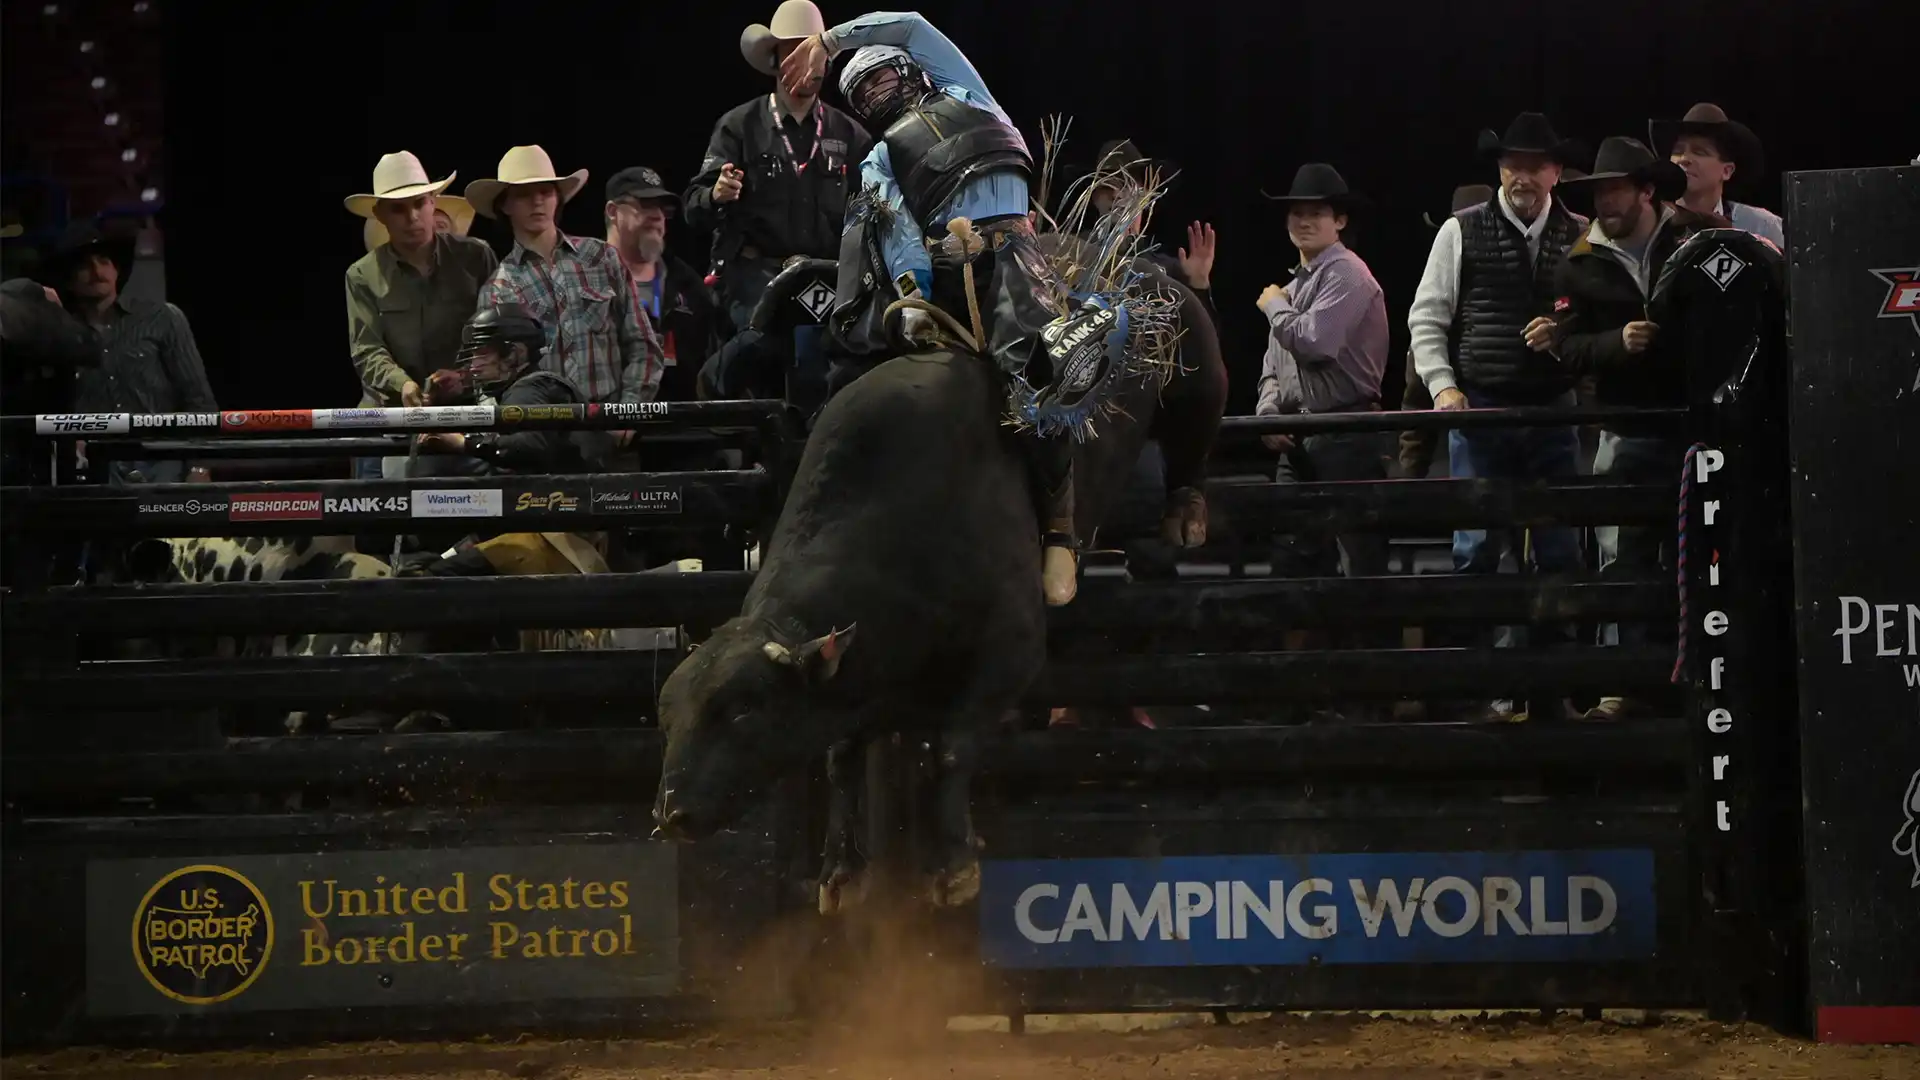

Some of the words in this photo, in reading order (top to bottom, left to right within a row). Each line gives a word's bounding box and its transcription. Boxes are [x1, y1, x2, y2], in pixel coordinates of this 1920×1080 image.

[604, 402, 668, 416] PENDLETON
[53, 421, 109, 432] TIRES
[132, 414, 174, 427] BOOT
[176, 413, 218, 426] BARN
[427, 494, 471, 504] Walmart
[640, 491, 679, 501] ULTRA
[139, 503, 185, 513] SILENCER
[201, 503, 228, 512] SHOP
[231, 500, 319, 512] PBRSHOP.COM
[180, 887, 224, 910] U.S.
[298, 872, 468, 918] United
[488, 872, 630, 912] States
[1014, 878, 1337, 944] CAMPING
[1347, 876, 1618, 939] WORLD
[151, 916, 252, 940] BORDER
[299, 922, 468, 967] Border
[489, 915, 636, 961] Patrol
[152, 943, 253, 967] PATROL
